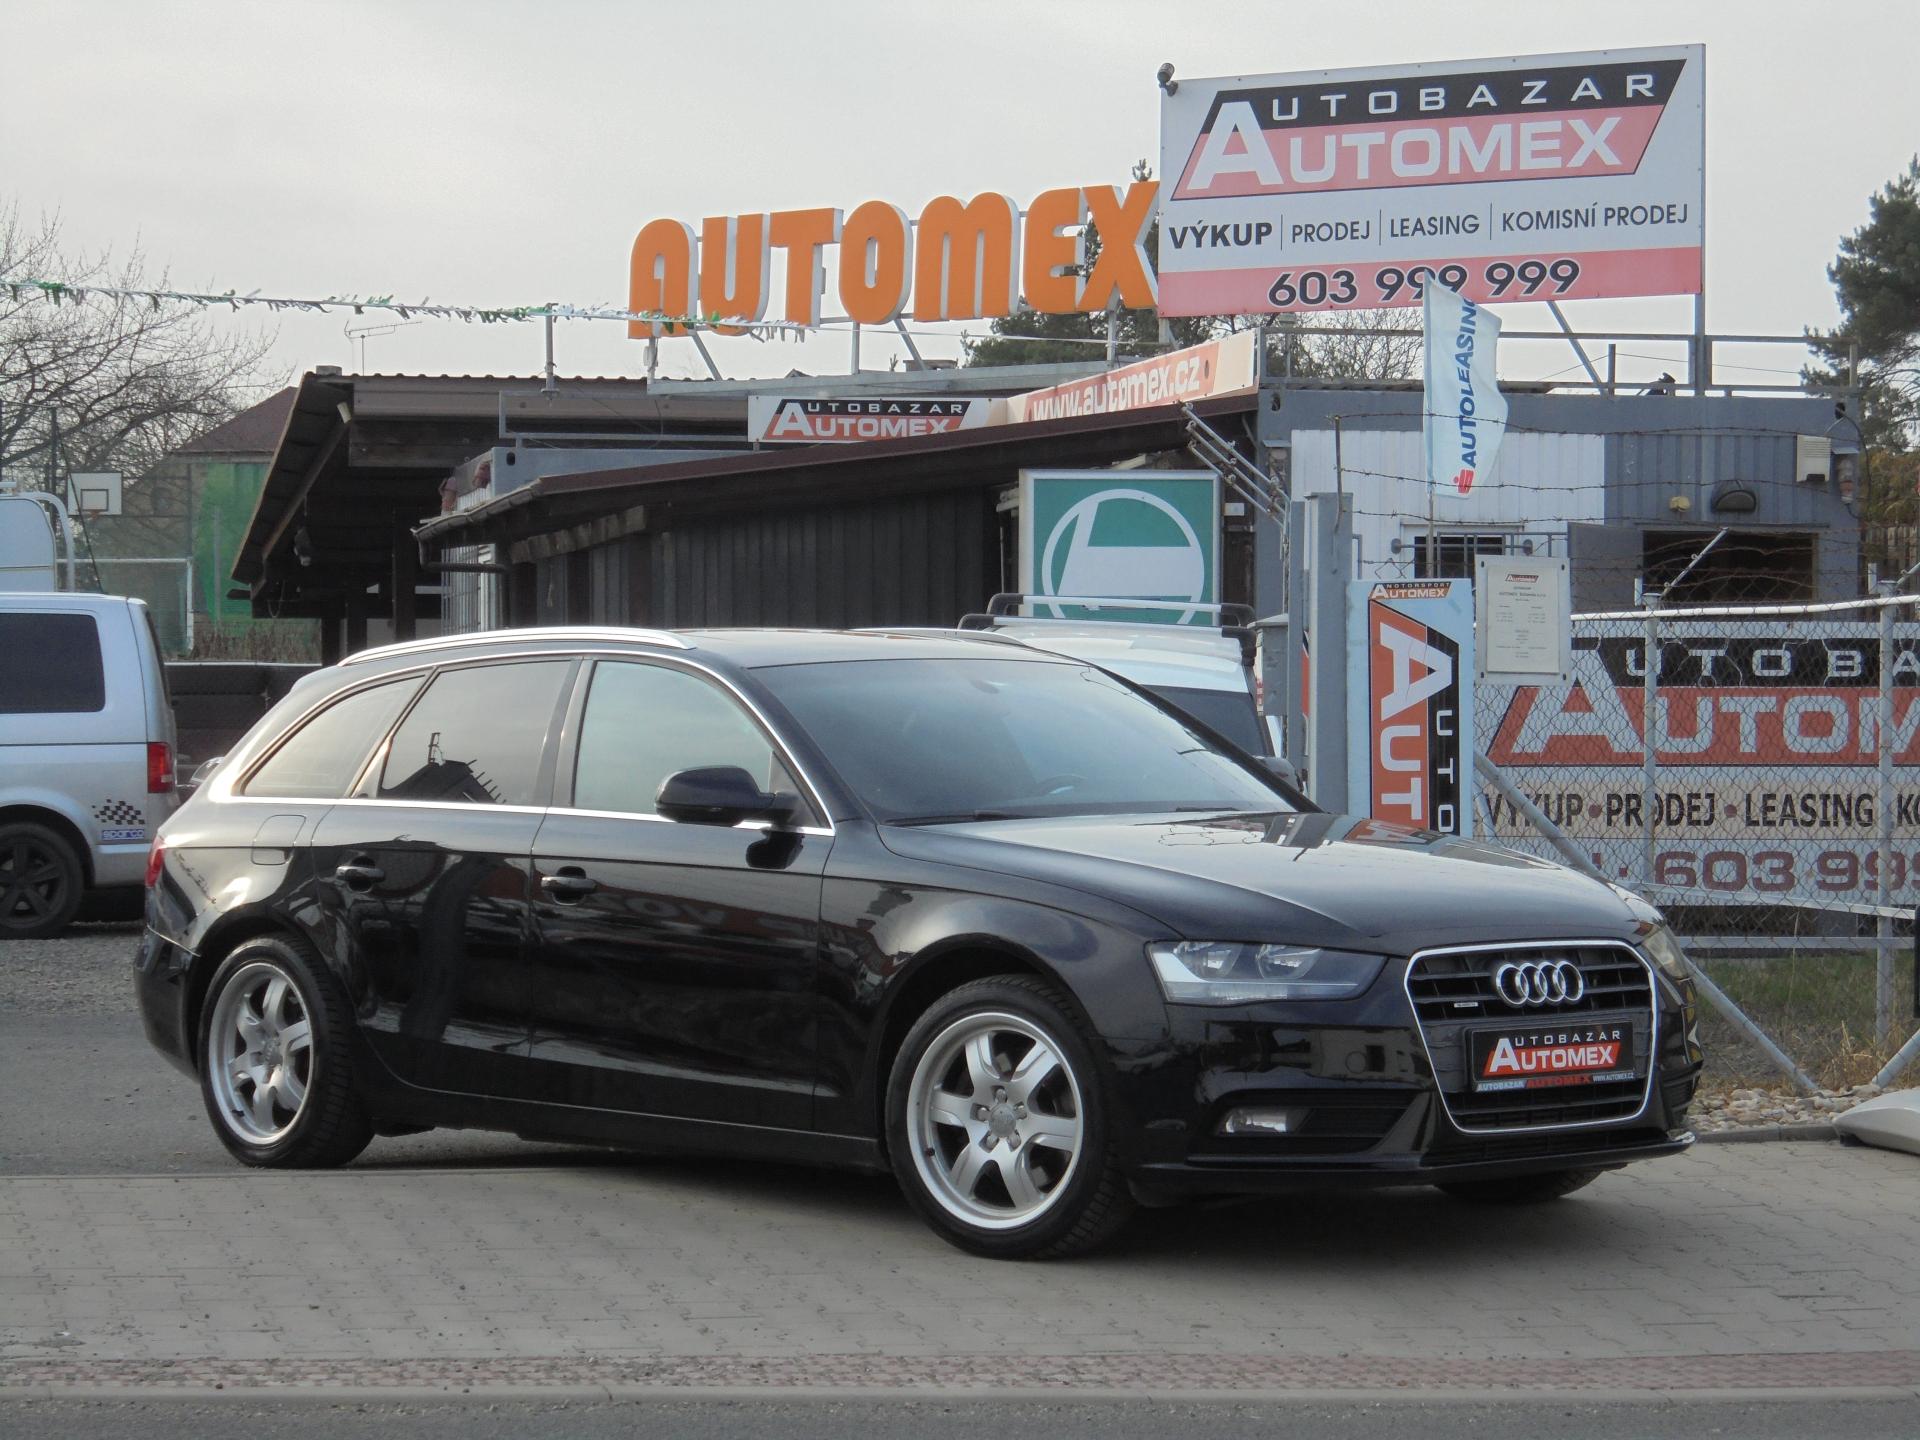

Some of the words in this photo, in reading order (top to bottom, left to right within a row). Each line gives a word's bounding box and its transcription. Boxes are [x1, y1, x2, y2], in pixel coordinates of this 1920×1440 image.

[1186, 100, 1622, 190] AUTOMEX
[1169, 219, 1273, 250] VÝKUP
[1292, 220, 1370, 243] PRODEJ
[1390, 214, 1480, 238] LEASING
[1502, 202, 1598, 232] KOMISNÍ
[1603, 203, 1688, 227] PRODEJ
[628, 180, 1160, 339] AUTOMEX
[1269, 269, 1358, 307] 603
[1375, 264, 1468, 302] 999
[1485, 258, 1581, 298] 999
[1033, 356, 1200, 422] www.automex.cz
[772, 402, 950, 437] AUTOMEX
[1371, 583, 1445, 599] AUTOMEX
[1379, 621, 1453, 821] AUT
[1745, 793, 1874, 827] LEASING
[1655, 850, 1795, 891] 603
[1816, 850, 1920, 892] 99
[1489, 1038, 1614, 1073] AUTOMEX
[1477, 1080, 1525, 1092] AUTOBAZAR
[1526, 1074, 1592, 1089] AUTOMEX
